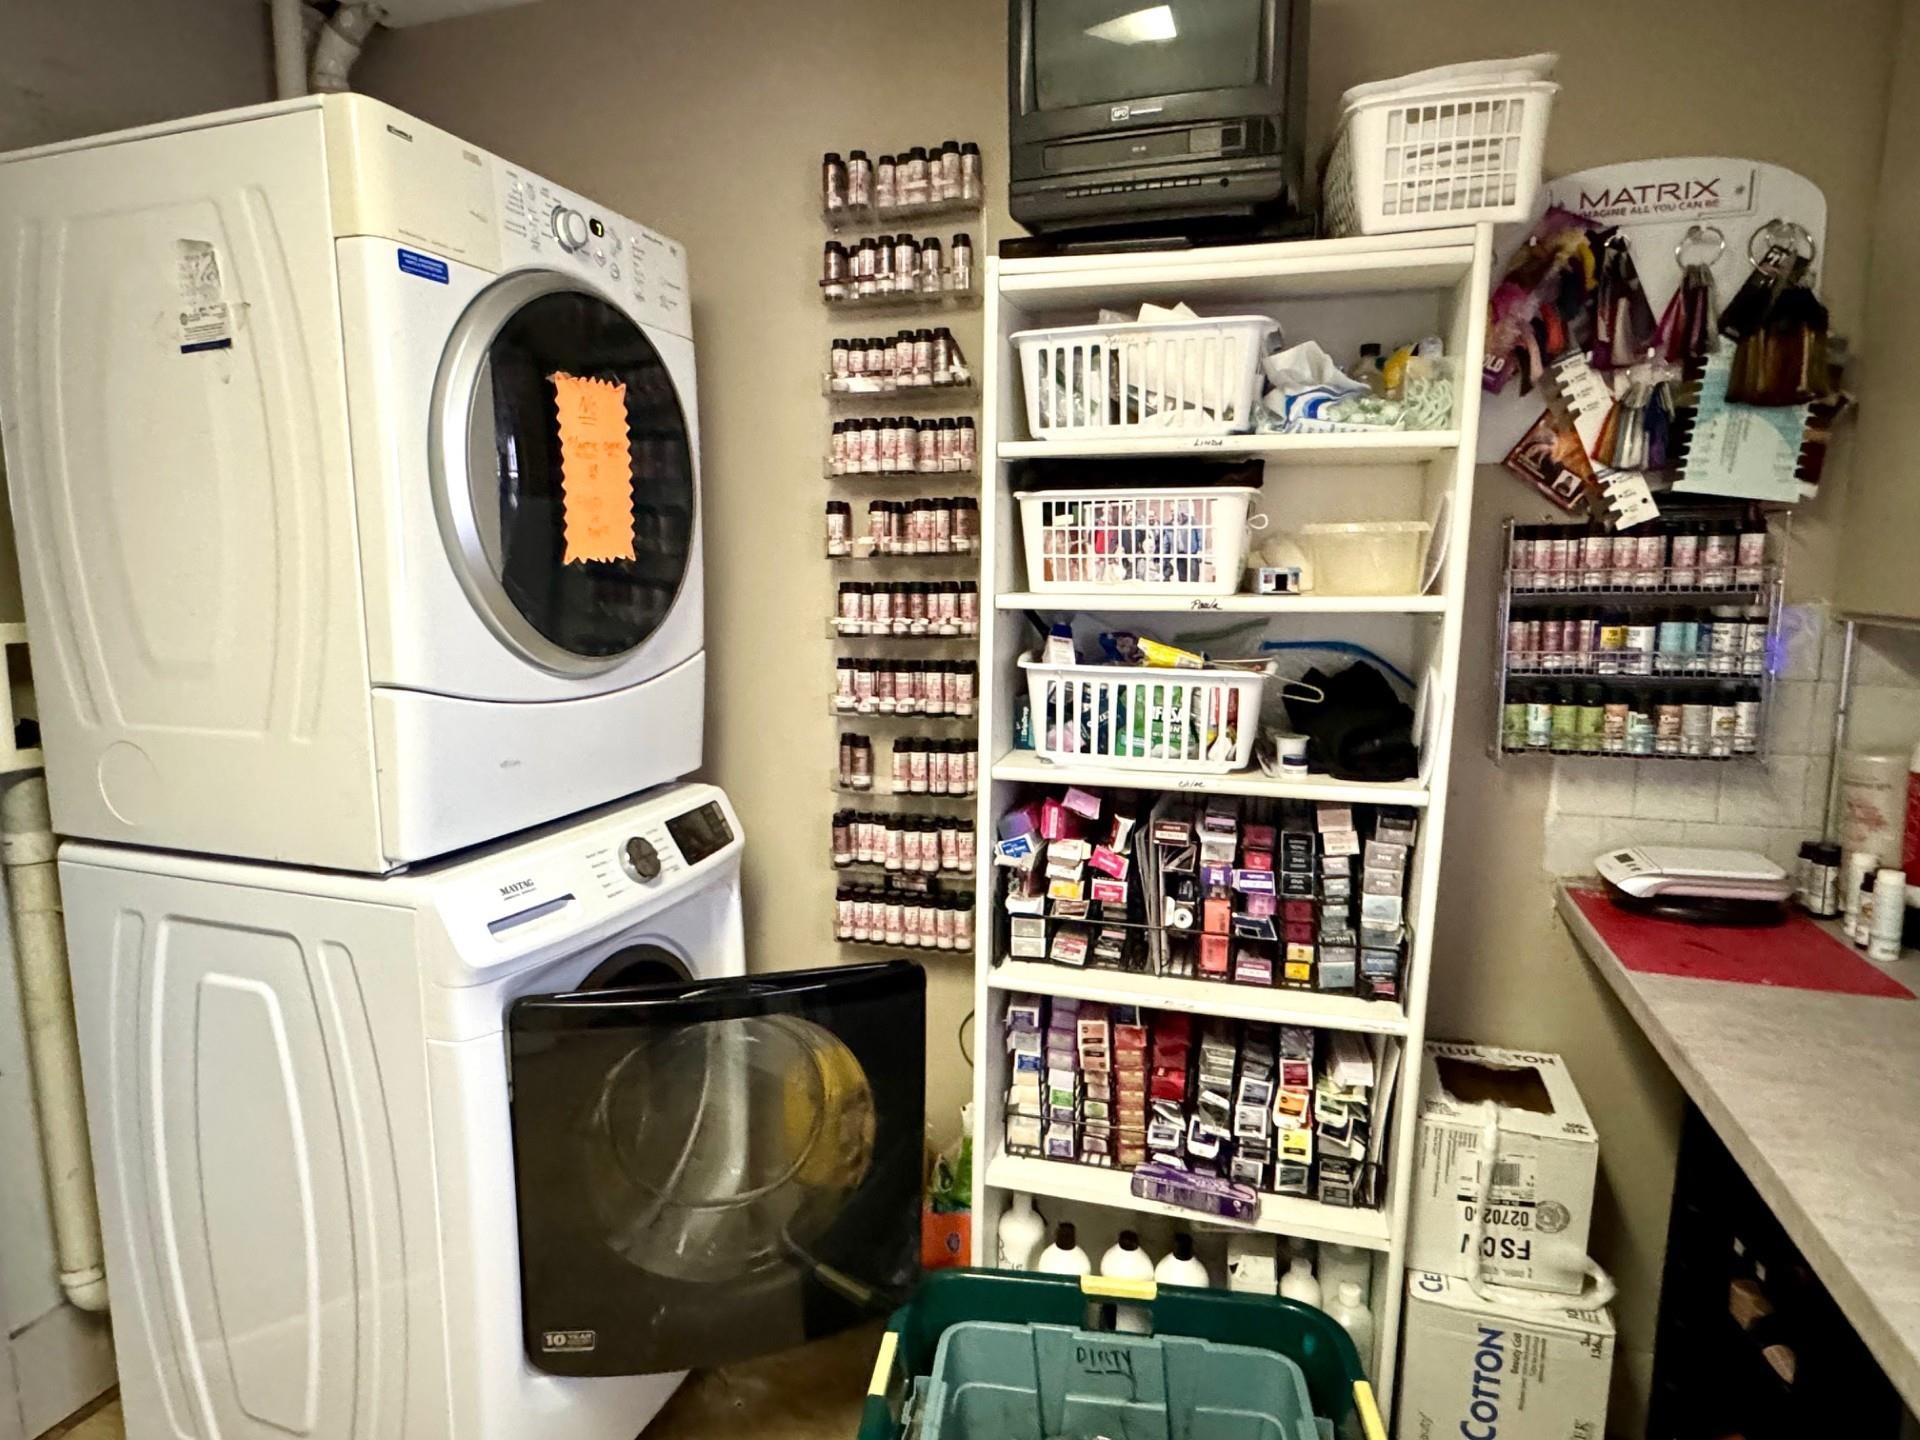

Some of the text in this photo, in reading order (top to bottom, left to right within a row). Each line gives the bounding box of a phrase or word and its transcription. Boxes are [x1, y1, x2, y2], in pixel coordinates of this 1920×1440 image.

[1579, 177, 1721, 209] MATRIX
[1630, 205, 1650, 214] ALL
[1653, 203, 1676, 213] YOU
[1679, 200, 1703, 211] CAN
[499, 878, 535, 896] MAYTAG
[545, 1334, 567, 1346] 10
[1076, 1346, 1134, 1373] DIRTY
